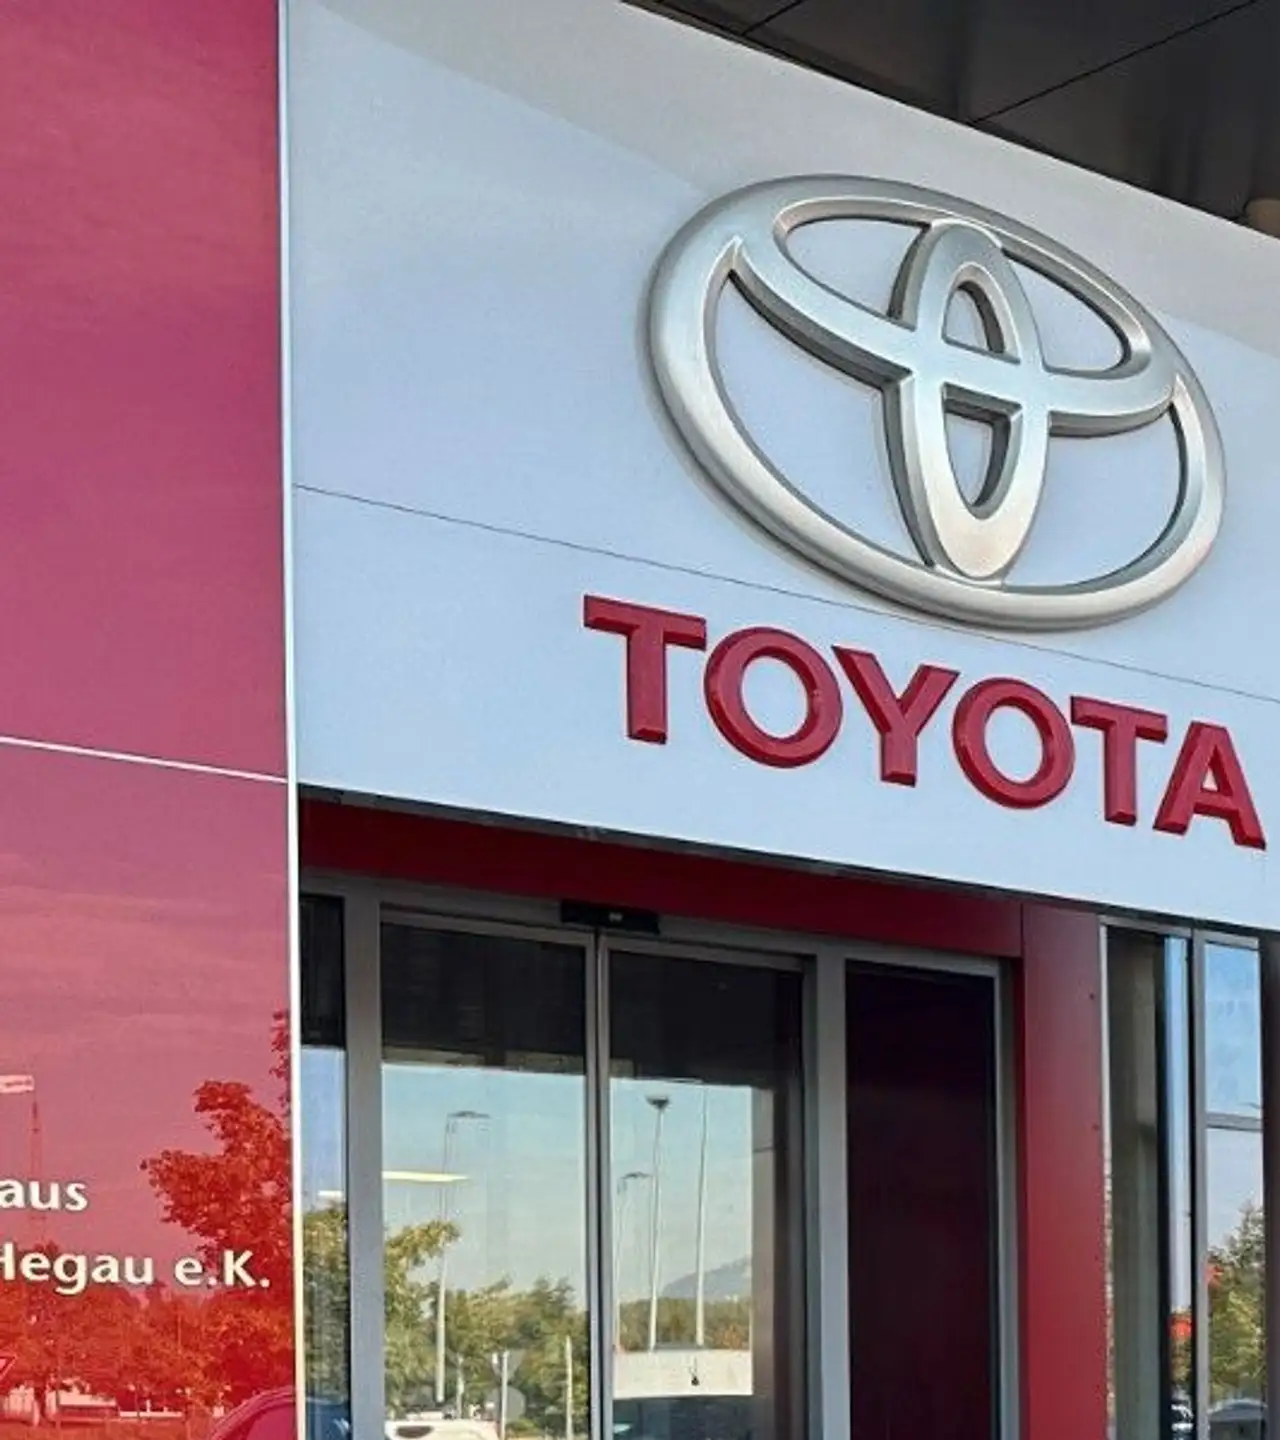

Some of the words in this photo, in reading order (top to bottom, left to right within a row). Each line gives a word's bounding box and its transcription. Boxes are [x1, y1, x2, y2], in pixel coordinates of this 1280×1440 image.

[583, 594, 1267, 851] TOYOTA
[0, 1178, 89, 1211] aus
[174, 1250, 272, 1289] e.K.
